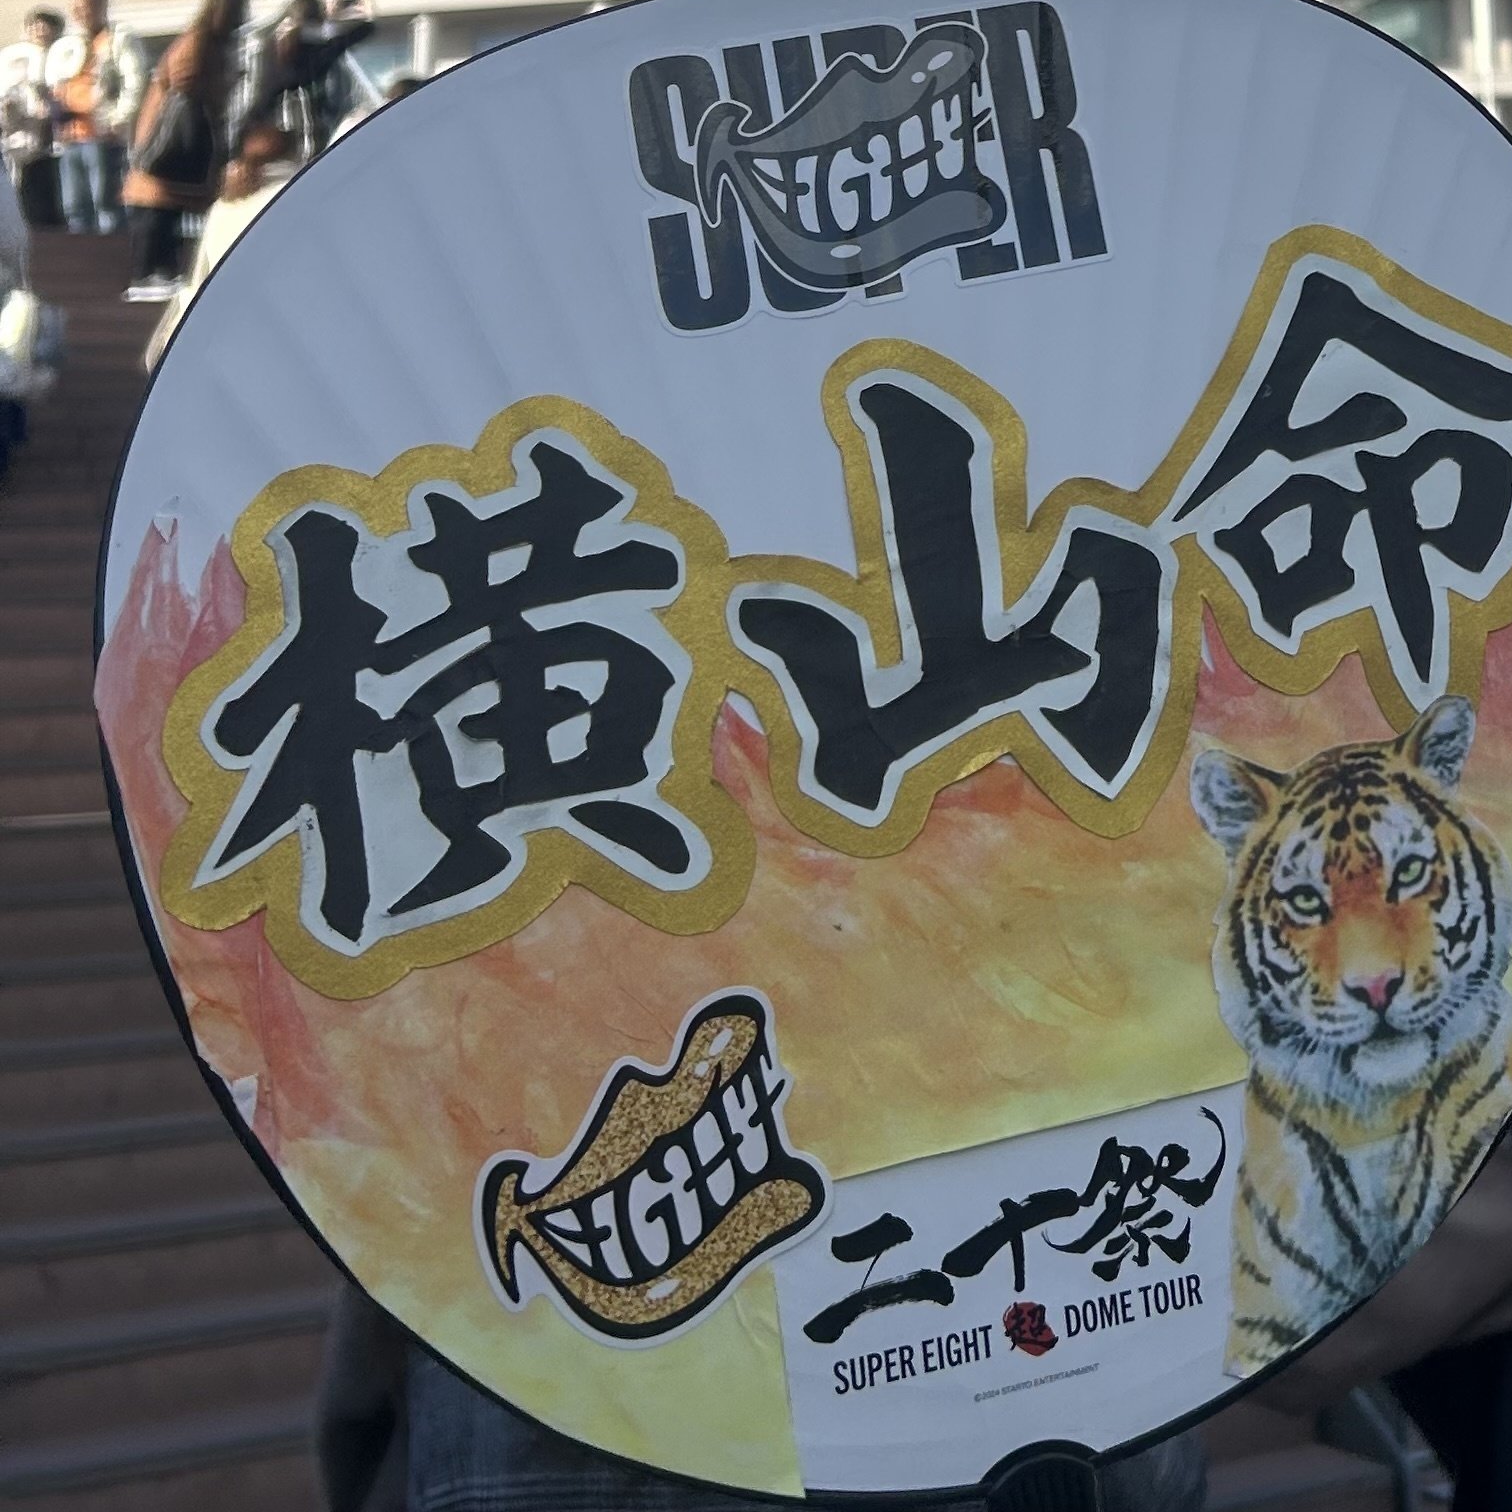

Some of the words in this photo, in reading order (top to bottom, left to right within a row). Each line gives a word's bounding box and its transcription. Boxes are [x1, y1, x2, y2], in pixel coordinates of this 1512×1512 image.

[804, 1106, 1226, 1342] 二十祭
[833, 1344, 916, 1394] SUPER
[922, 1325, 993, 1372] EIGHT
[1064, 1289, 1135, 1337] DOME
[1139, 1274, 1203, 1317] TOUR
